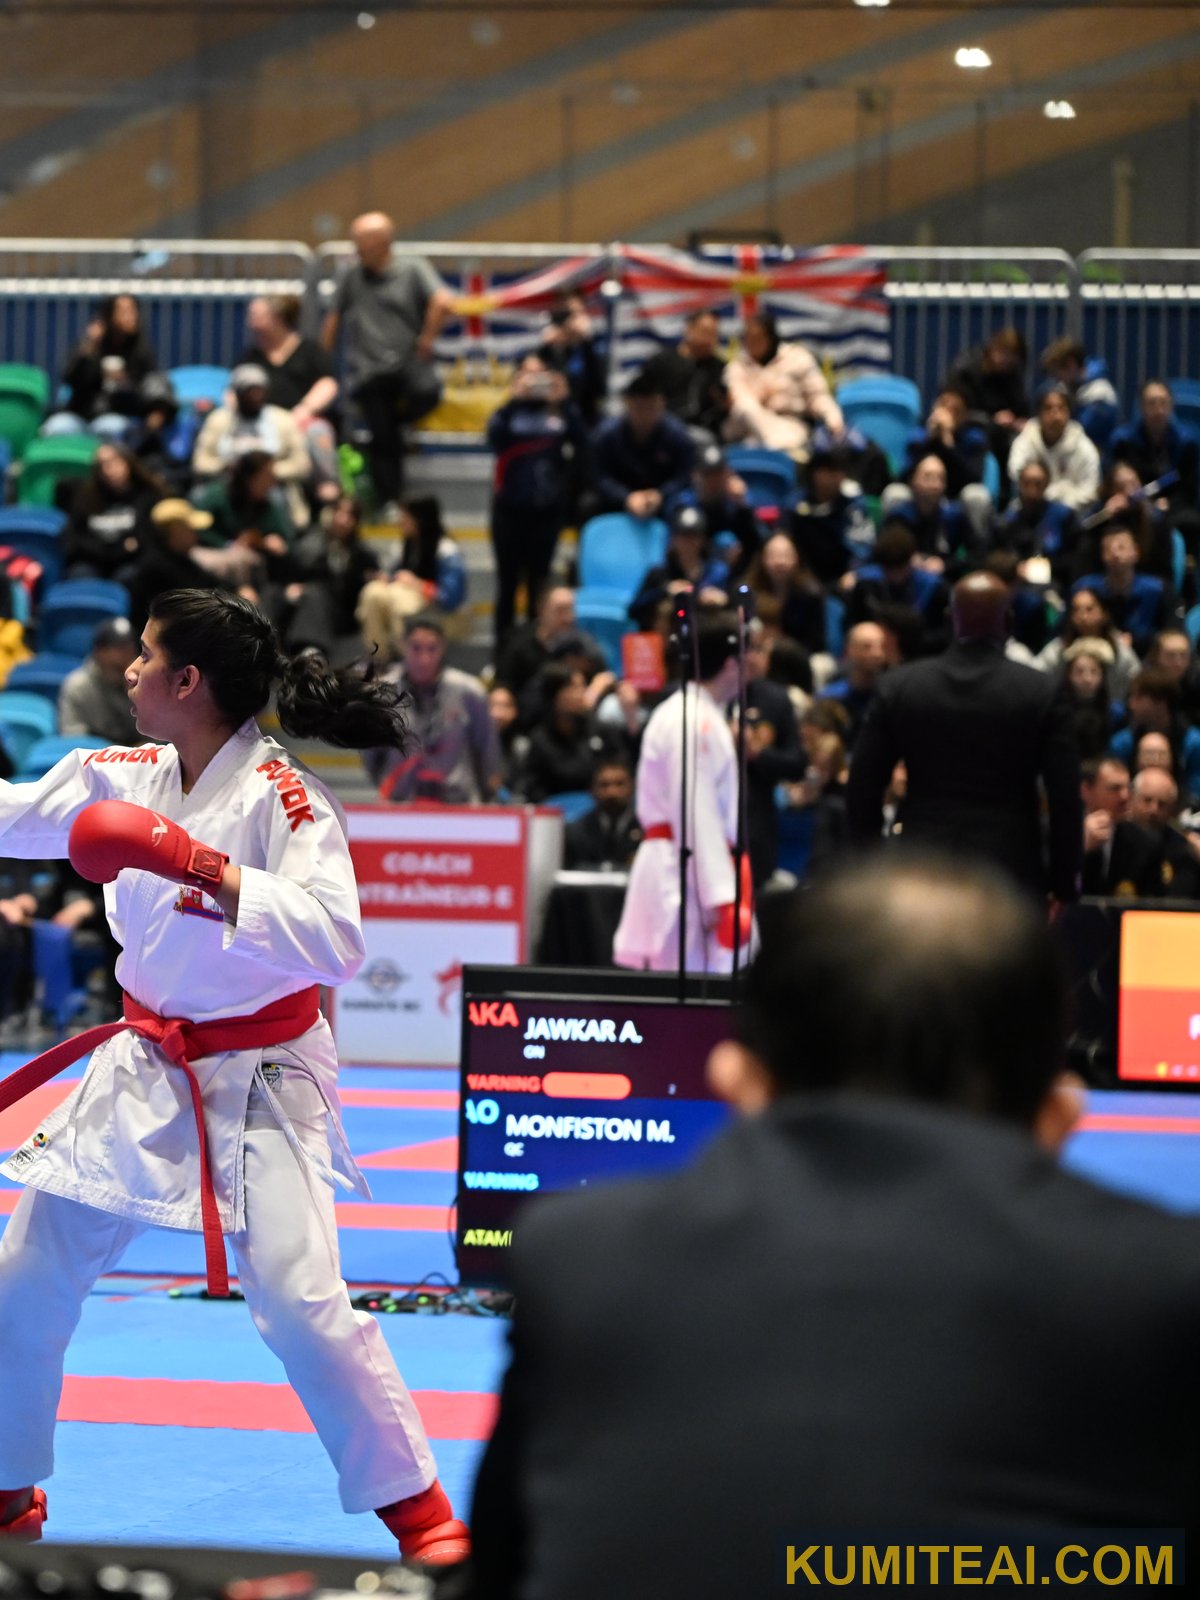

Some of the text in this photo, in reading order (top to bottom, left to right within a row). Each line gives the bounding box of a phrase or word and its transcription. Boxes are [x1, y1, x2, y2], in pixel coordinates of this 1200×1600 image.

[381, 851, 474, 876] COACH
[523, 1016, 643, 1044] JAWKAR A.
[505, 1114, 676, 1143] MONFISTON M.
